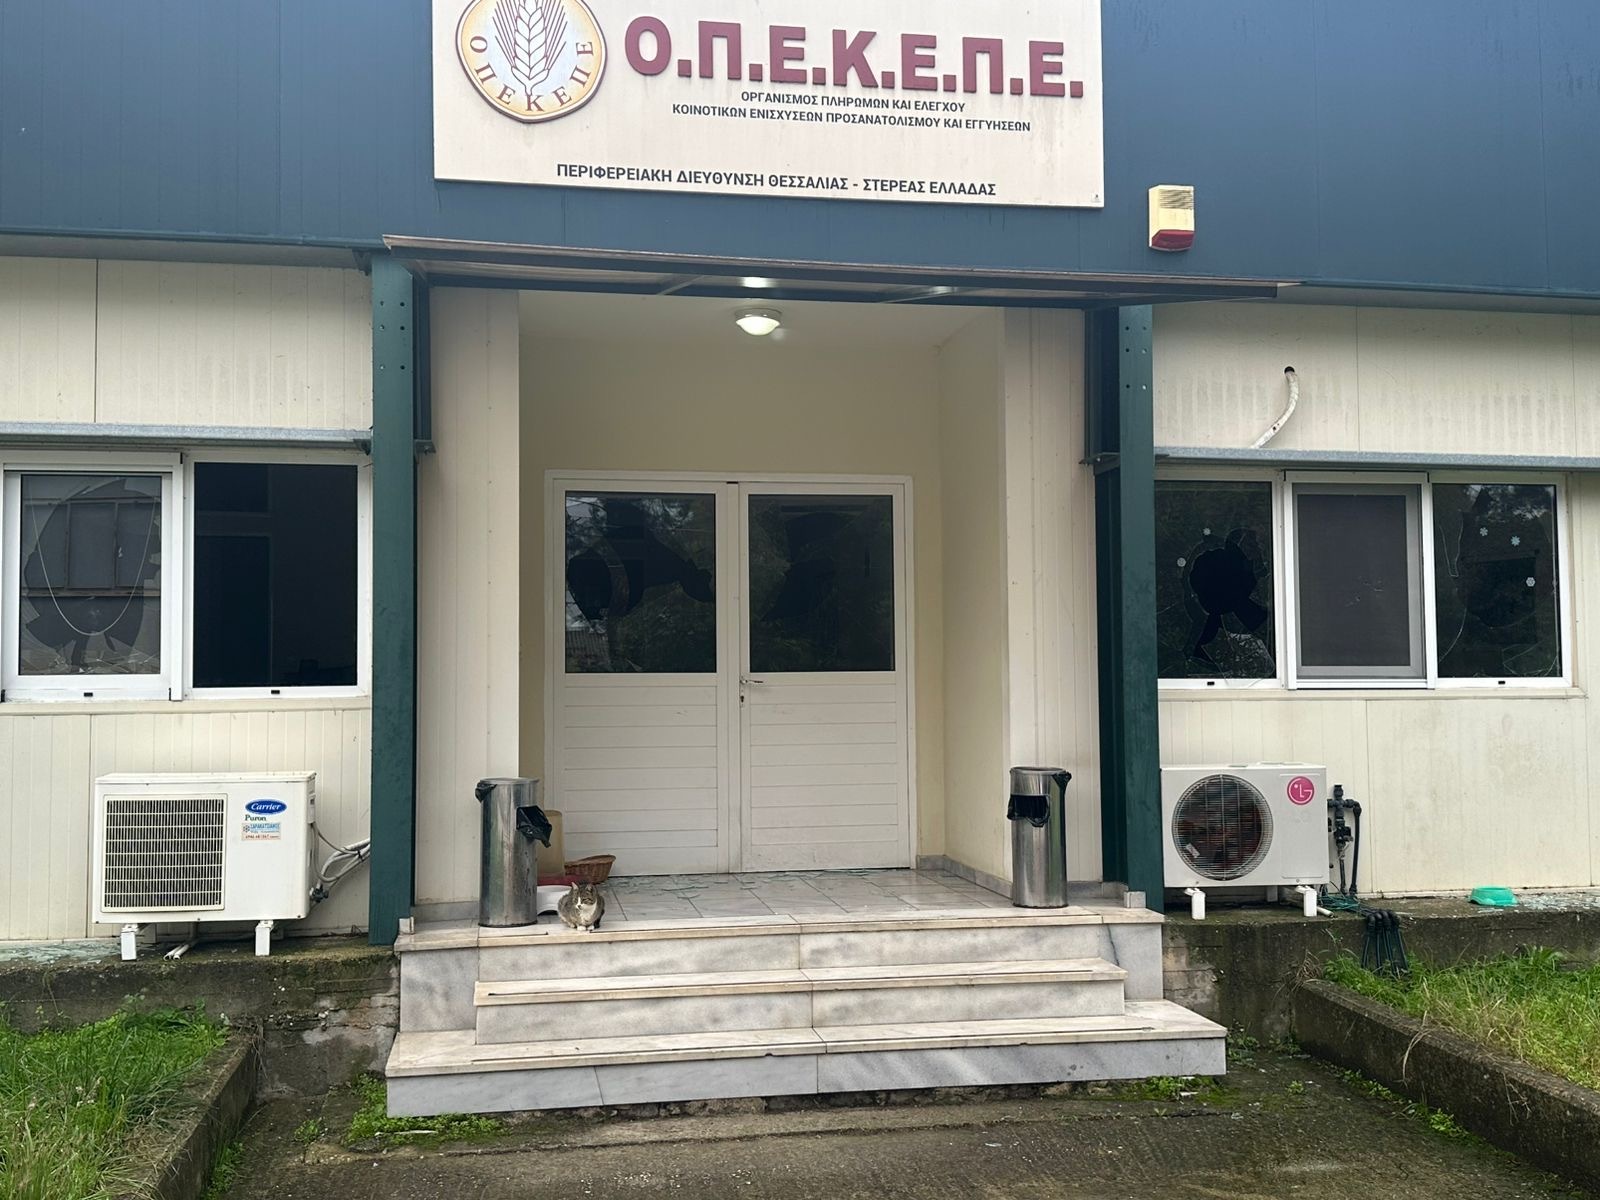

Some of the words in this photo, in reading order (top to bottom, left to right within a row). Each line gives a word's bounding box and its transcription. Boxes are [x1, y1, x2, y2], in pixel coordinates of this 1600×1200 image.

[625, 16, 1083, 98] Ο.Π.Ε.Κ.Ε.Π.Ε.
[742, 92, 817, 105] ΟΡΓΑΝΙΣΜΟΣ
[822, 96, 889, 109] ΠΛΗΡΩΜΩΝ
[893, 101, 911, 110] ΚΑΙ
[915, 101, 965, 112] ΕΛΕΓΧΟΥ
[673, 104, 746, 117] ΚΟΙΝΟΤΙΚΩΝ
[750, 109, 823, 122] ΕΝΙΣΧΥΣΕΩΝ
[826, 113, 940, 128] ΠΡΟΣΑΝΑΤΟΛΙΣΜΟΥ
[944, 119, 962, 129] ΚΑΙ
[966, 120, 1031, 131] ΕΓΓΥΗΣΕΩΝ
[557, 164, 672, 182] ΠΕΡΙΦΕΡΕΙΑΚΗ
[677, 171, 764, 186] ΔΙΕΥΘΥΝΣΗ
[769, 175, 848, 190] ΘΕΣΣΑΛΙΑΣ
[863, 179, 925, 193] ΣΤΕΡΕΑΣ
[930, 182, 996, 196] ΕΛΛΑΔΑΣ
[1288, 777, 1313, 804] LG
[251, 803, 281, 811] Carrier
